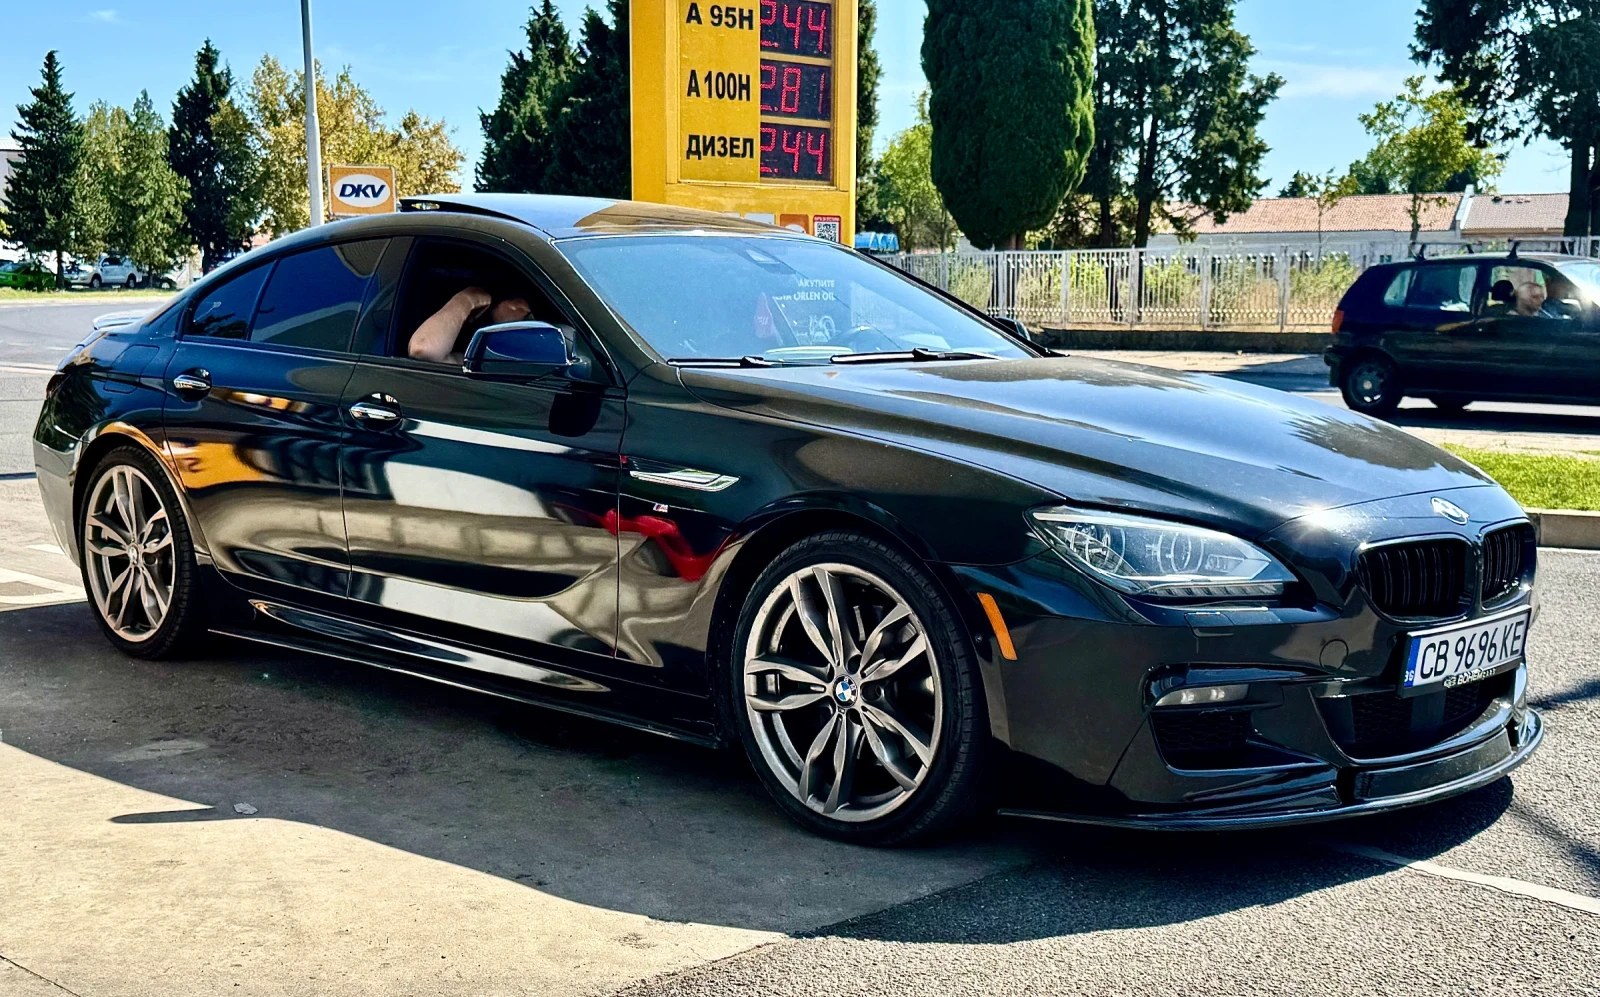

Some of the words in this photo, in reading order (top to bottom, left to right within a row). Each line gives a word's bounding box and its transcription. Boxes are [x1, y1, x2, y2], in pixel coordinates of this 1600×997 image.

[686, 3, 702, 25] А
[710, 5, 754, 30] 95Н
[687, 70, 701, 97] А
[704, 71, 751, 101] 100Н
[760, 64, 826, 114] 2.81
[686, 134, 755, 160] ДИЗЕЛ
[760, 127, 825, 175] 2.44
[339, 184, 386, 198] DKV
[793, 291, 821, 301] ORLEN
[821, 291, 836, 301] OIL
[798, 279, 836, 288] АКУПИТЕ
[1420, 640, 1449, 679] CB
[1454, 627, 1498, 673] 9696
[1499, 620, 1524, 660] KE
